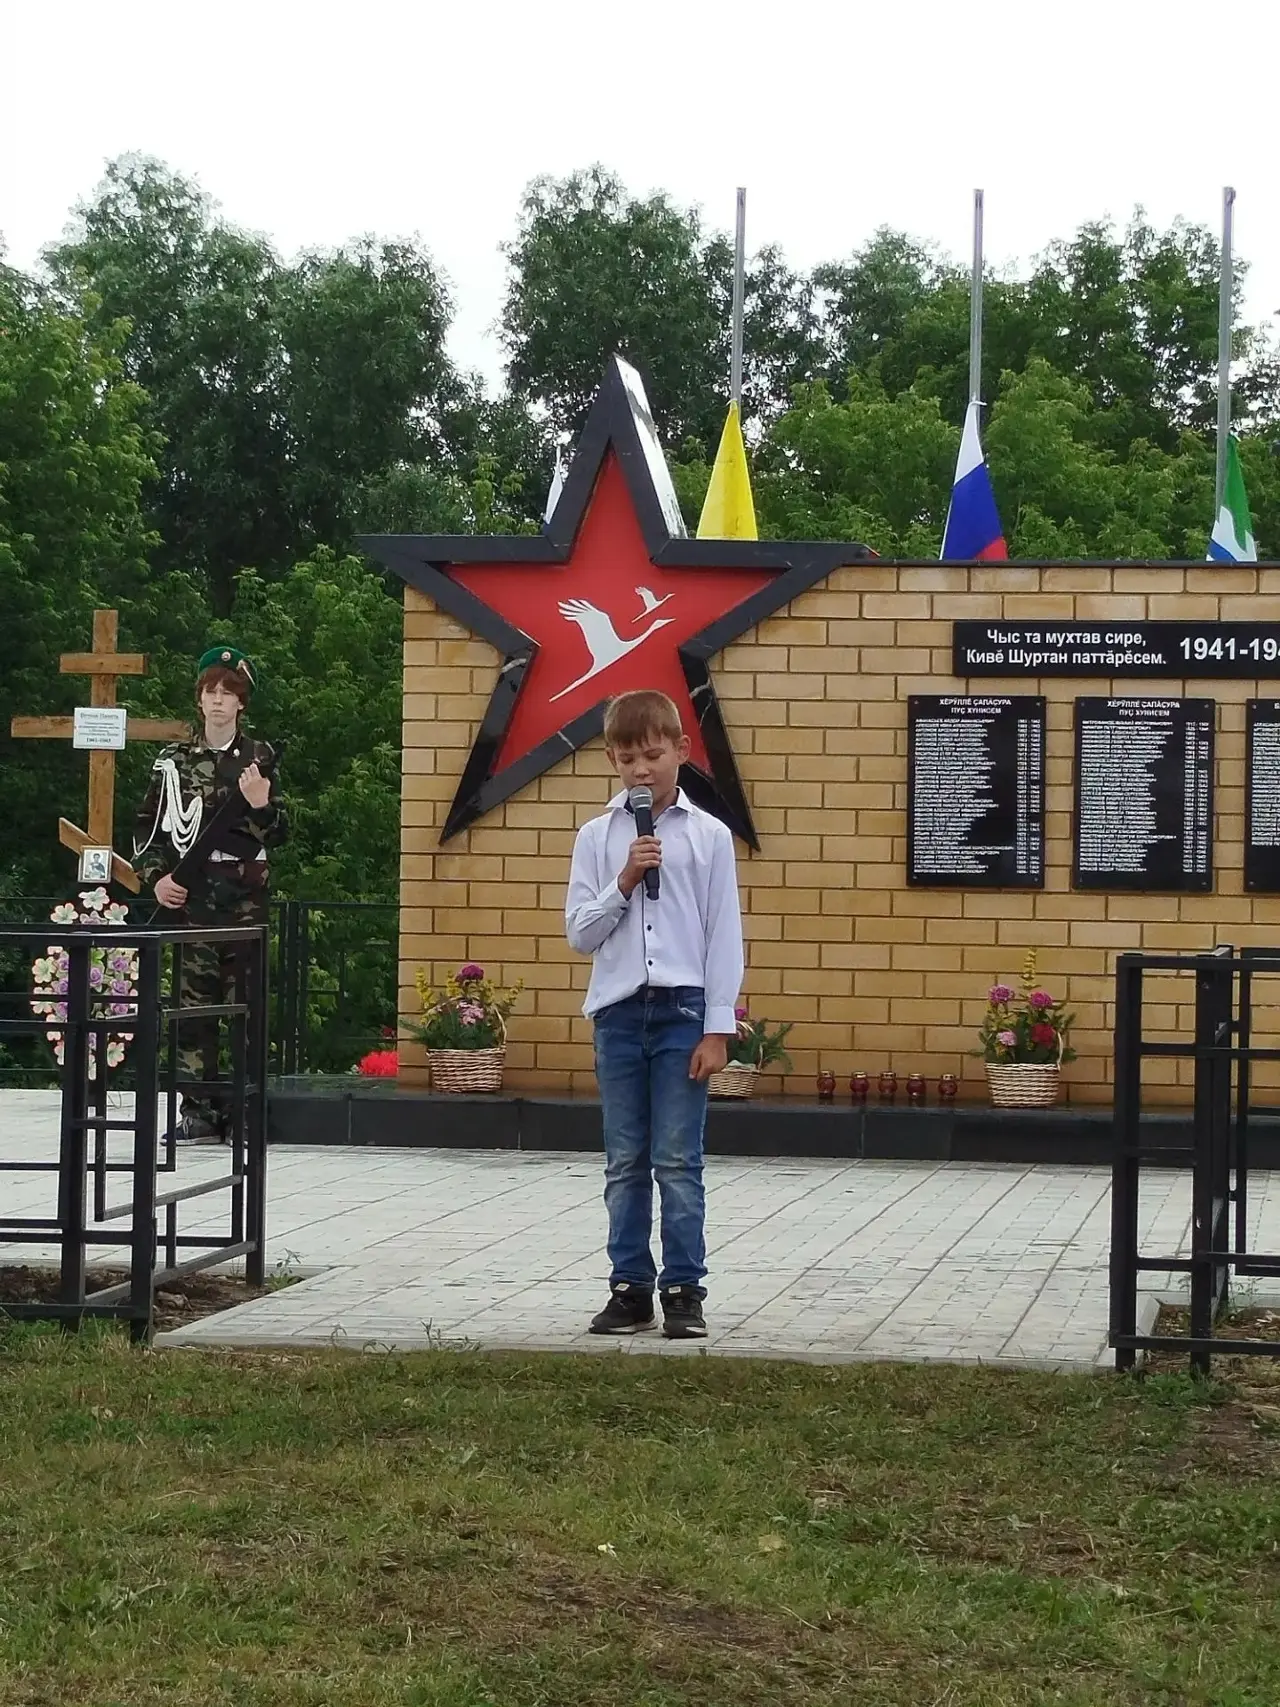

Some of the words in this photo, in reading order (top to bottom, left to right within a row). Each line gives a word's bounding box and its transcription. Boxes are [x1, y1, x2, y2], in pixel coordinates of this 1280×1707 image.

[987, 629, 1020, 643] Чыс
[1024, 632, 1041, 643] та
[1045, 632, 1101, 647] мухтав
[1105, 632, 1146, 647] сире,
[967, 649, 1004, 663] Кивӗ
[1008, 649, 1068, 667] Шуртан
[1072, 650, 1167, 667] паттӑрӗсем.
[1179, 637, 1280, 661] 1941-19
